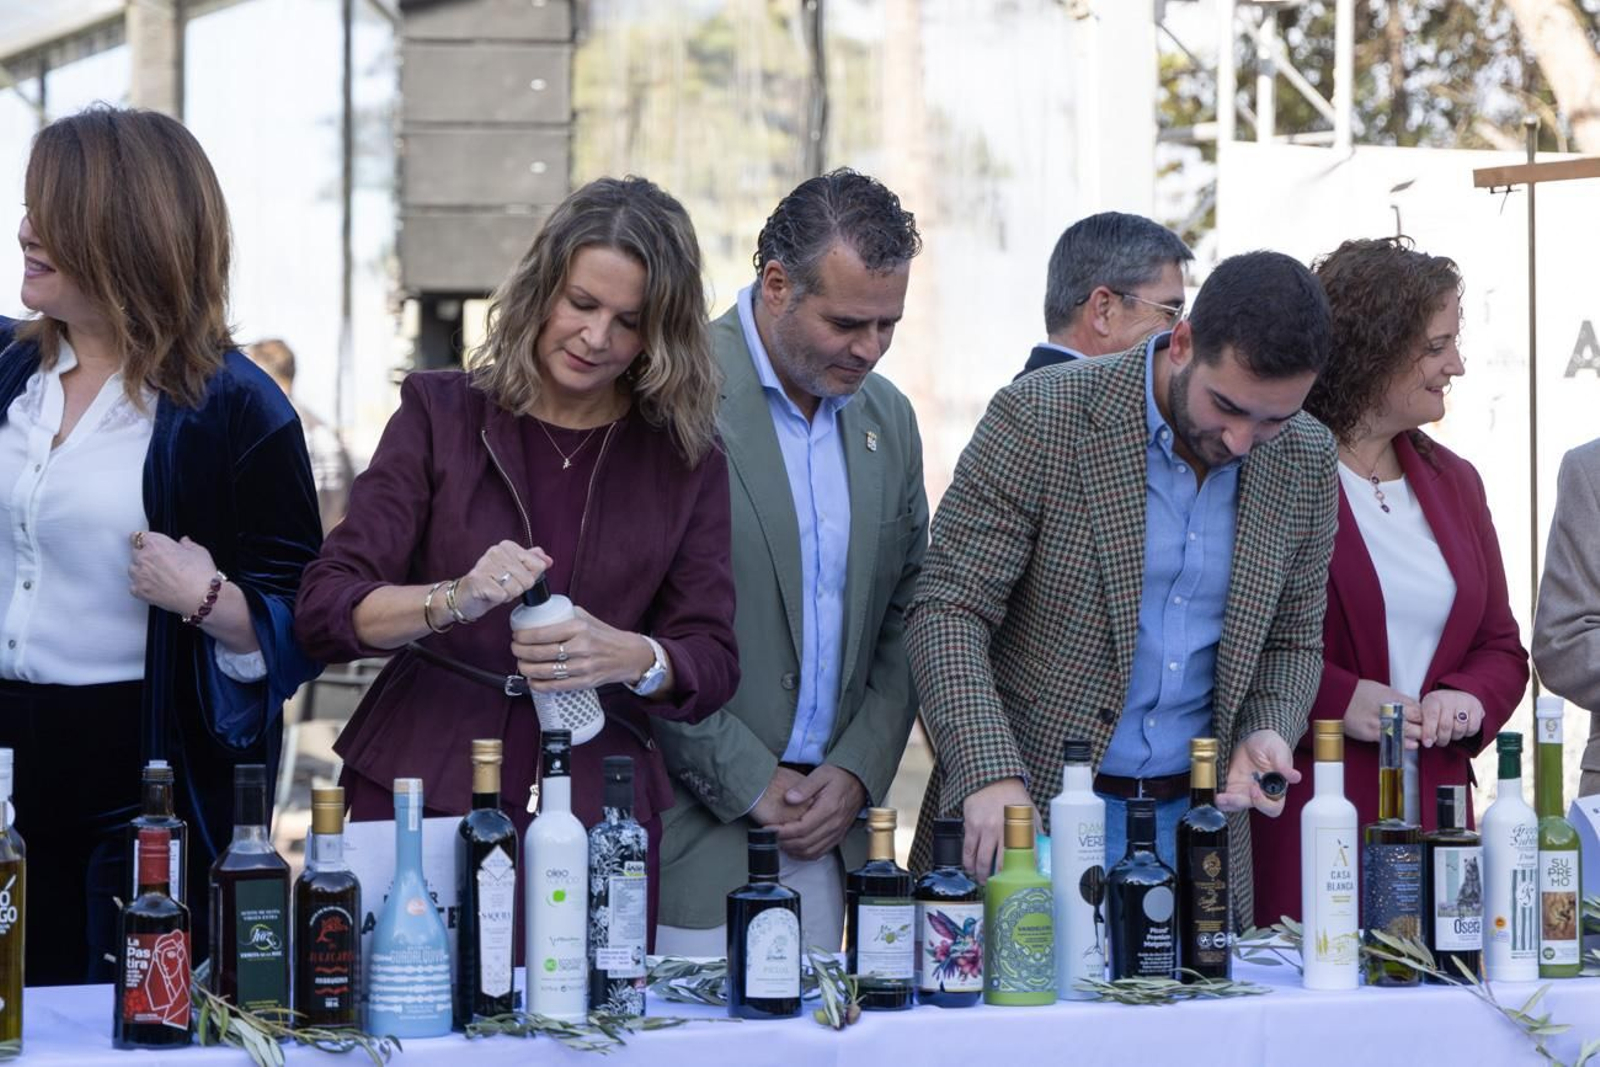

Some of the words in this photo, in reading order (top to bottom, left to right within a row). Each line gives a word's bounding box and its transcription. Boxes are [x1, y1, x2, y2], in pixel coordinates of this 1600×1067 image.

[1551, 858, 1569, 867] SU
[546, 870, 569, 878] oleo
[1331, 870, 1351, 879] CASA
[1547, 868, 1572, 877] PRE
[1327, 882, 1354, 892] BLANCA
[1551, 878, 1570, 887] MO
[127, 938, 139, 946] La
[127, 947, 150, 958] Pas
[126, 958, 148, 969] tira
